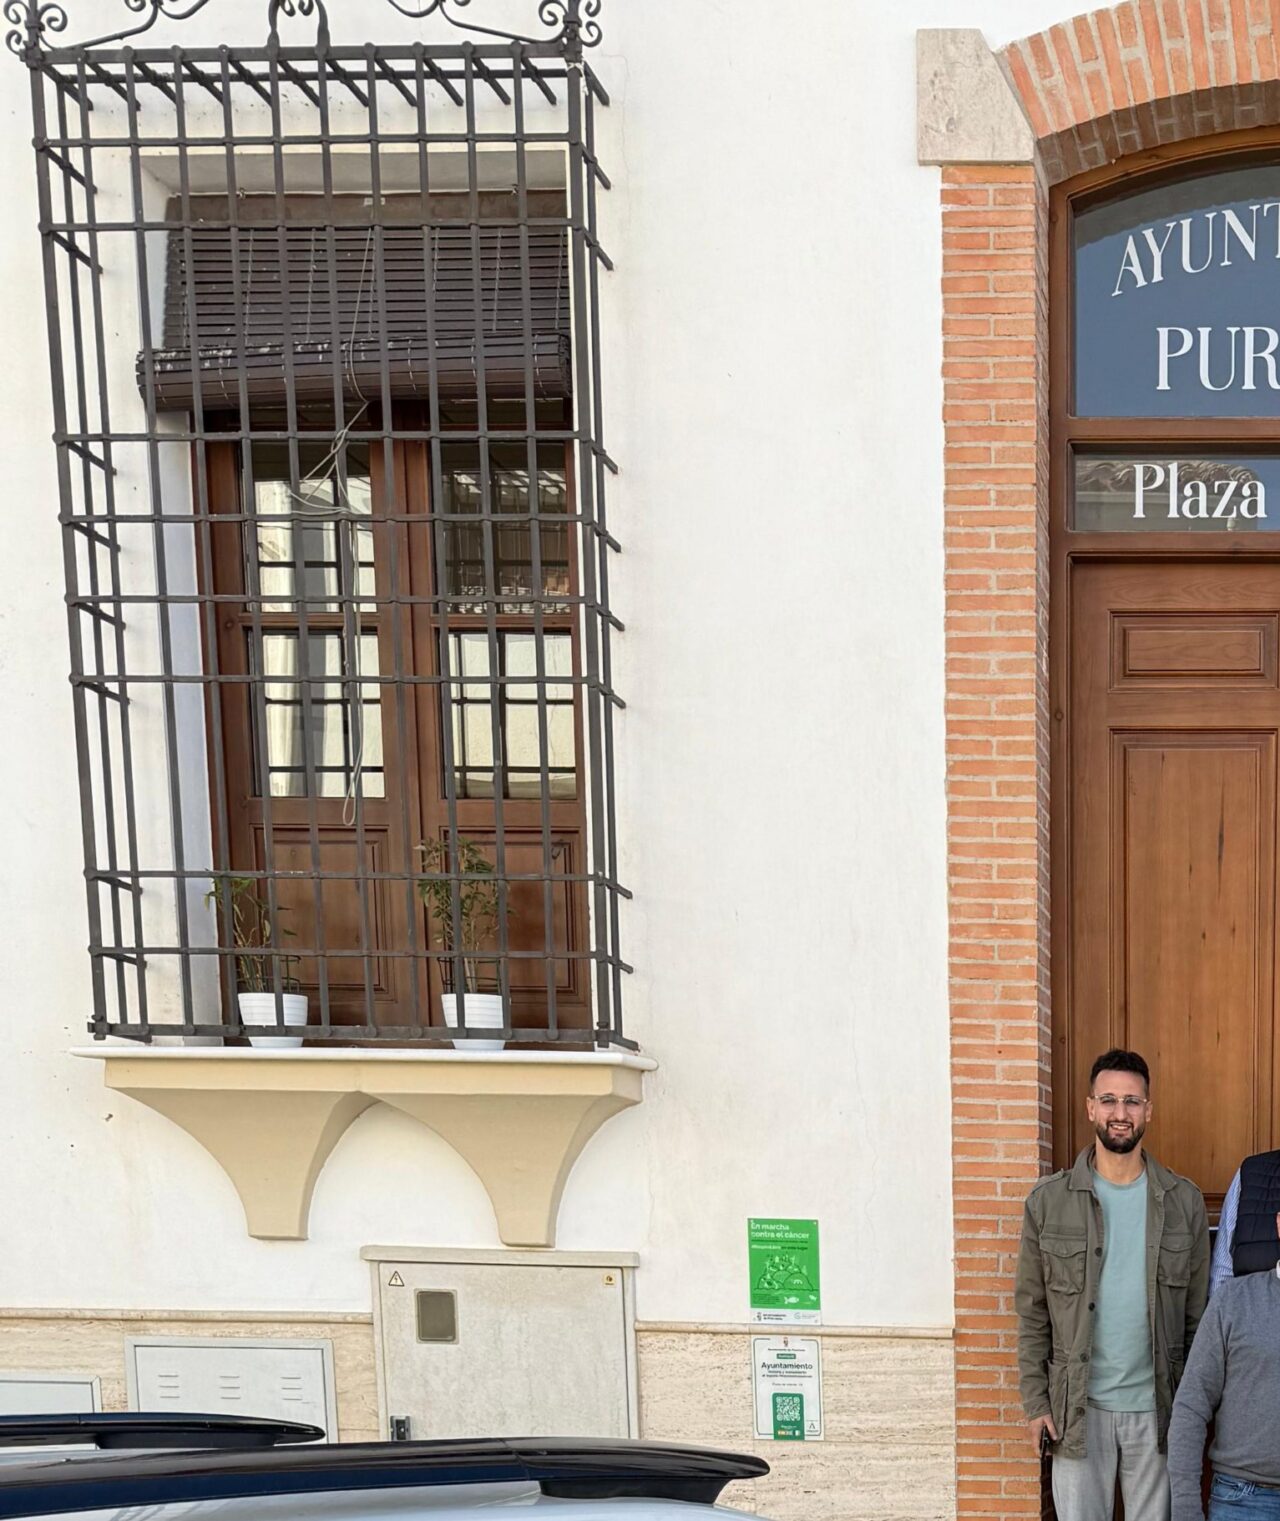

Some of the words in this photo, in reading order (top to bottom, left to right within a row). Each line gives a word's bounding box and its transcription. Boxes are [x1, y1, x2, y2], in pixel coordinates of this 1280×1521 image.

[1131, 462, 1268, 519] Plaza
[751, 1231, 775, 1239] contra
[776, 1231, 783, 1239] el
[761, 1362, 812, 1370] Ayuntamiento
